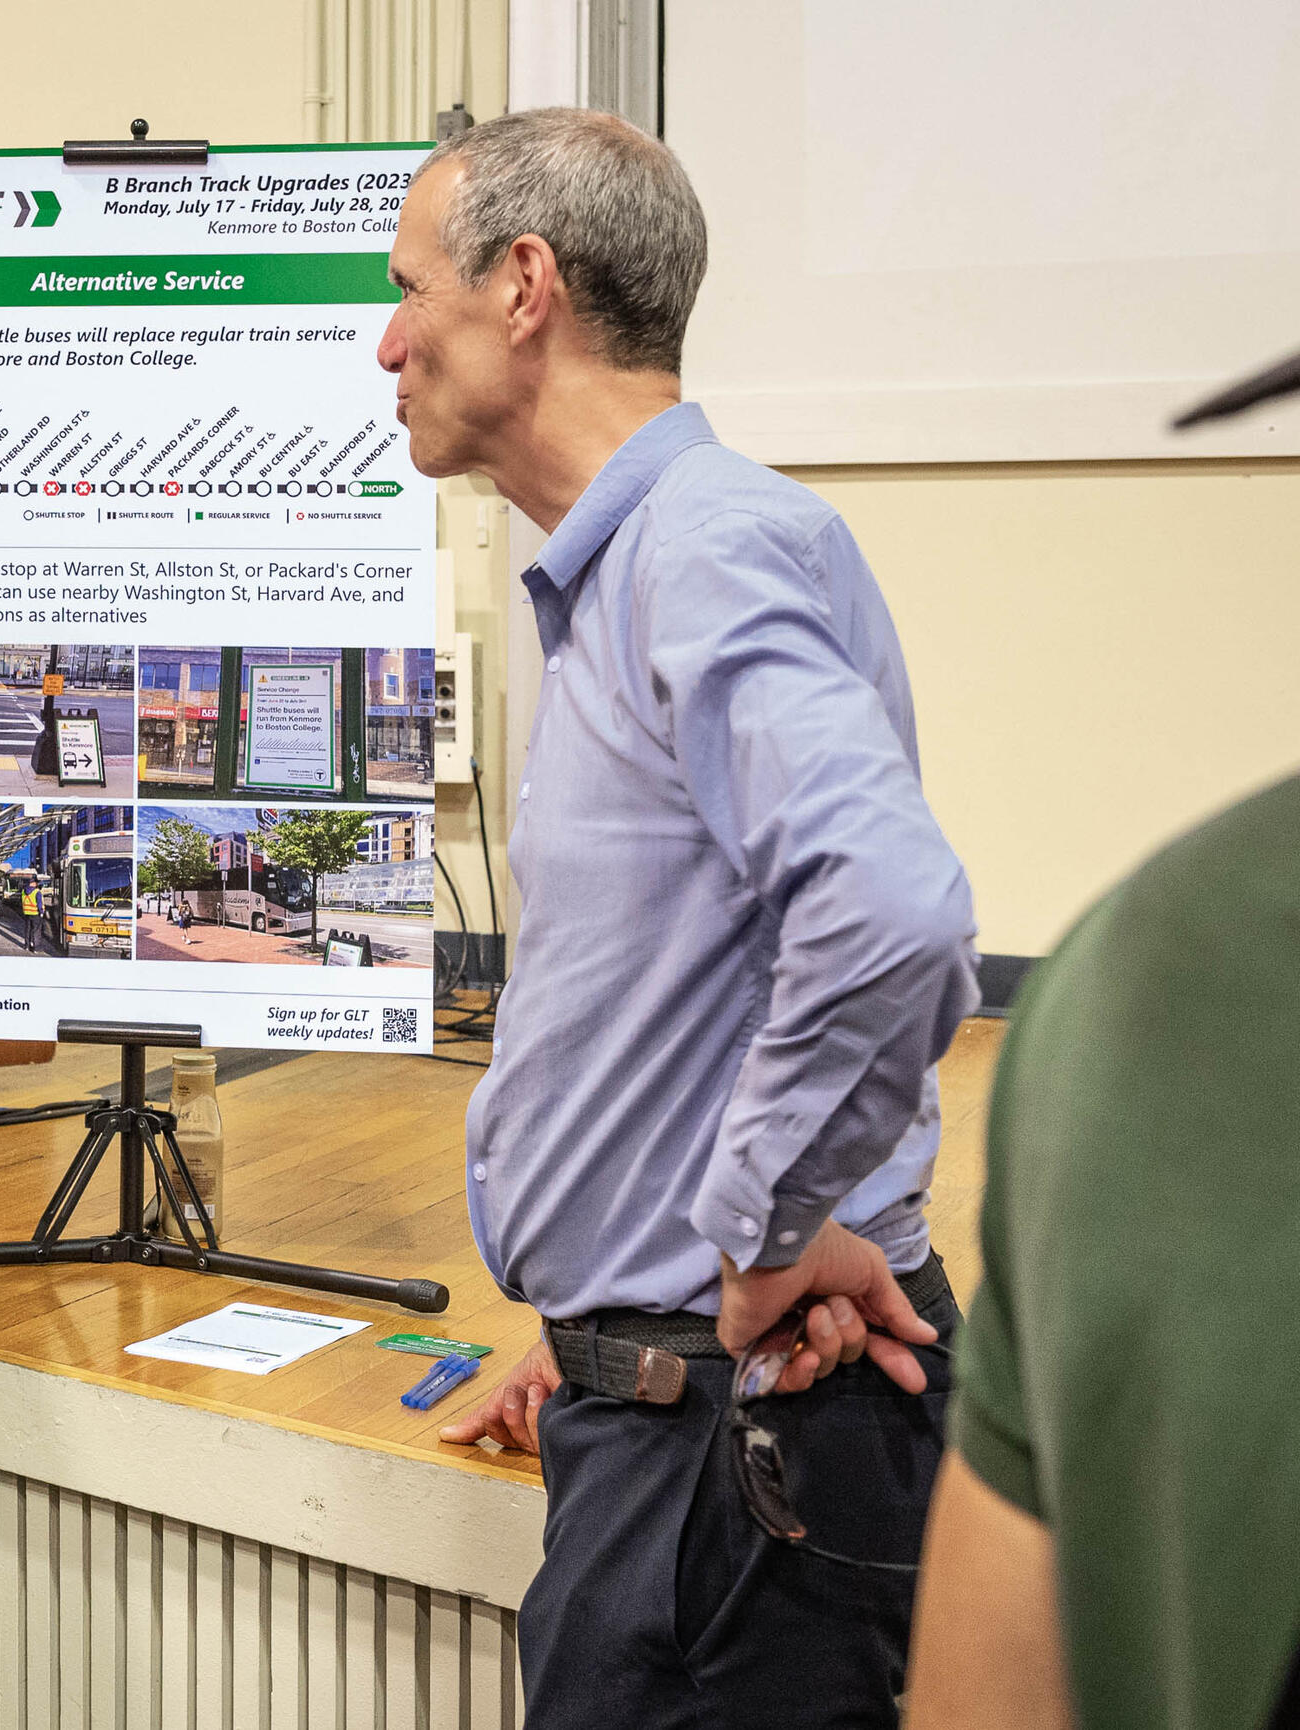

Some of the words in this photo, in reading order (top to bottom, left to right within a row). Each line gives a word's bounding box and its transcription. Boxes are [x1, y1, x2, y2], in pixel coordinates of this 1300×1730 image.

[106, 178, 119, 193] B
[125, 176, 192, 193] Branch
[200, 175, 251, 192] Track
[257, 174, 349, 196] Upgrades
[357, 173, 412, 193] (2023
[104, 200, 171, 218] Monday,
[176, 199, 210, 217] July
[217, 199, 235, 213] 17
[251, 198, 305, 216] Friday,
[310, 197, 345, 215] July
[349, 197, 373, 213] 28,
[379, 197, 406, 210] 20
[207, 221, 277, 234] Kenmore
[282, 221, 297, 233] to
[303, 220, 356, 233] Boston
[362, 217, 402, 232] Colle
[30, 271, 157, 291] Alternative
[163, 270, 245, 290] Service
[24, 327, 71, 343] buses
[77, 327, 108, 342] will
[113, 327, 175, 347] replace
[181, 326, 244, 346] regular
[249, 326, 290, 341] train
[296, 325, 356, 341] service
[28, 350, 61, 366] and
[66, 351, 124, 366] Boston
[130, 350, 197, 370] College.
[37, 416, 50, 429] RD
[20, 424, 73, 476] WASHINGTON
[71, 413, 85, 427] ST
[140, 439, 177, 477] HARVARD
[177, 423, 194, 441] AVE
[168, 436, 208, 477] PACKARDS
[207, 406, 239, 437] CORNER
[319, 431, 366, 477] BLANDFORD
[365, 419, 376, 433] ST
[48, 443, 83, 476] WARREN
[81, 432, 92, 445] ST
[80, 442, 113, 478] ALLSTON
[111, 432, 122, 444] ST
[109, 447, 137, 477] GRIGGS
[136, 437, 147, 450] ST
[199, 440, 236, 477] BABCOCK
[234, 430, 245, 443] ST
[230, 447, 257, 478] AMORY
[257, 437, 267, 449] ST
[259, 464, 272, 477] BU
[271, 432, 306, 465] CENTRAL
[288, 464, 301, 477] BU
[300, 444, 320, 466] EAST
[352, 438, 391, 477] KENMORE
[364, 484, 397, 493] NORTH
[1, 562, 37, 580] stop
[43, 563, 59, 576] at
[64, 561, 124, 576] Warren
[130, 562, 149, 579] St,
[155, 561, 213, 577] Allston
[220, 562, 238, 580] St,
[245, 566, 263, 578] or
[269, 562, 348, 578] Packard's
[354, 563, 412, 578] Corner
[28, 588, 56, 599] use
[62, 584, 119, 604] nearby
[124, 584, 225, 605] Washington
[232, 585, 250, 603] St,
[258, 585, 324, 601] Harvard
[330, 587, 365, 604] Ave,
[372, 586, 404, 602] and
[29, 611, 46, 622] as
[51, 607, 147, 623] alternatives
[257, 706, 282, 714] Shuttle
[292, 724, 323, 732] College.
[267, 1007, 296, 1022] Sign
[300, 1011, 317, 1023] up
[320, 1008, 340, 1023] for
[344, 1009, 370, 1021] GLT
[267, 1025, 313, 1041] weekly
[316, 1026, 374, 1041] updates!
